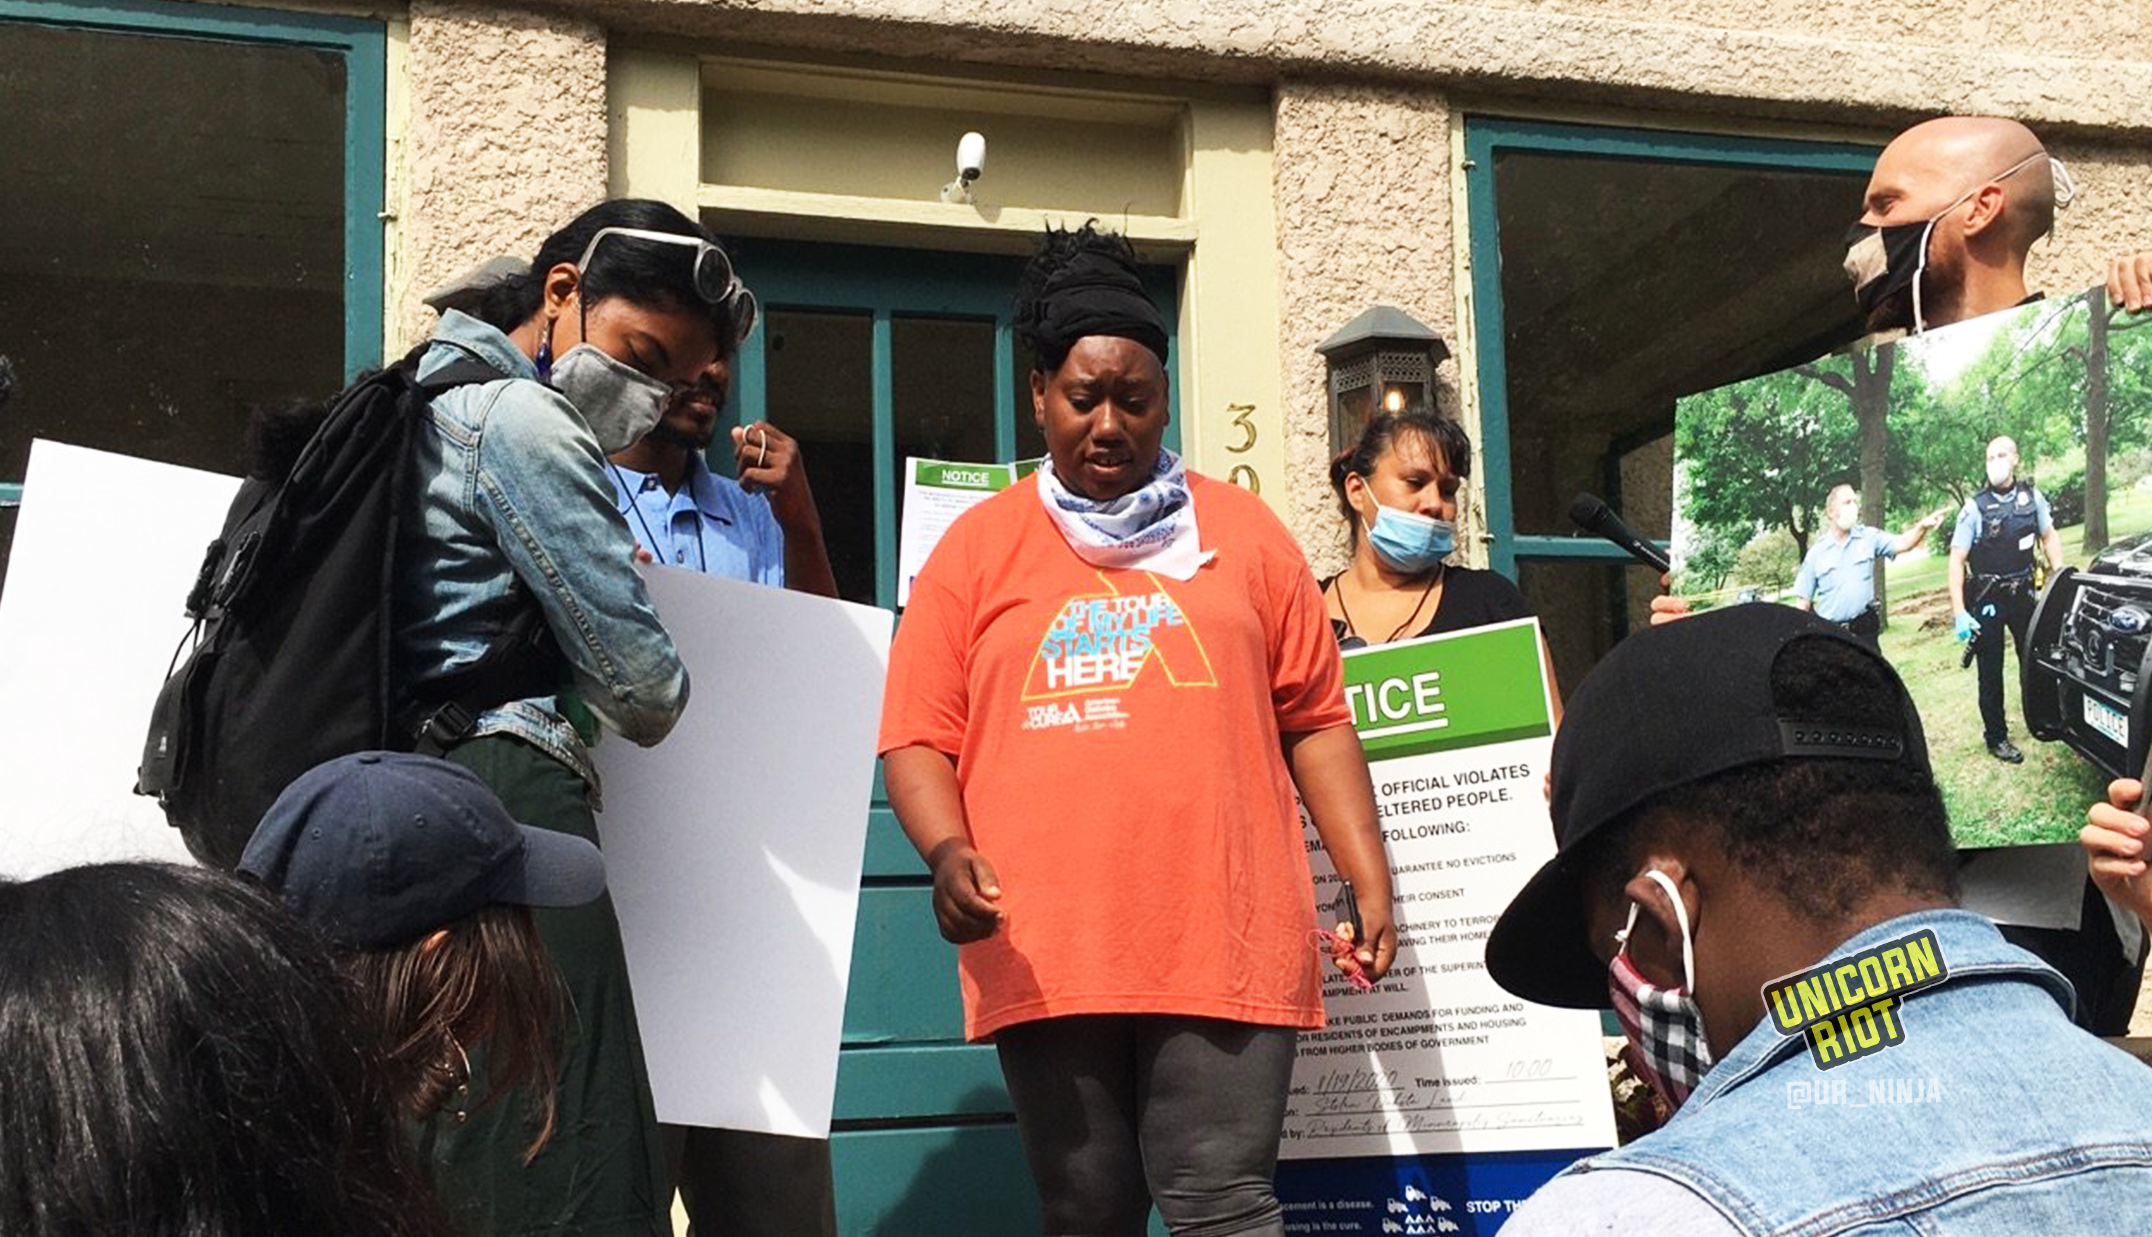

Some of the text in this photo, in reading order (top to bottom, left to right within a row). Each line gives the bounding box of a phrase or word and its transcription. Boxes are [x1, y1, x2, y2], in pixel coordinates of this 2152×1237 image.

[941, 469, 989, 482] NOTICE
[1111, 592, 1172, 614] TOUR
[1041, 625, 1152, 659] STARTS
[1046, 651, 1145, 689] HERE
[1344, 671, 1445, 726] TICE
[2086, 698, 2126, 738] POLICE
[1381, 775, 1450, 797] OFFICIAL
[1453, 763, 1531, 787] VIOLATES
[1376, 787, 1514, 819] ELTERED PEOPLE.
[1381, 820, 1471, 842] FOLLOWING:
[1391, 860, 1444, 876] UARANTEE
[1446, 858, 1461, 869] NO
[1463, 852, 1517, 867] EVICTIONS
[1392, 893, 1416, 904] HEIR
[1418, 888, 1465, 902] CONSENT
[1444, 918, 1457, 928] TO
[1397, 936, 1427, 948] AVING
[1429, 933, 1459, 945] THEIR
[1403, 966, 1417, 977] OF
[1418, 965, 1438, 976] THE
[1440, 960, 1487, 973] SUPERIN
[1322, 987, 1370, 998] AMPMENT
[1343, 1013, 1378, 1025] PUBLIC
[1381, 1009, 1431, 1022] DEMANDS
[1431, 1008, 1453, 1018] FOR
[1455, 1004, 1500, 1016] FUNDING
[1502, 1002, 1524, 1013] AND
[1310, 1029, 1364, 1042] RESIDENTS
[1364, 1028, 1379, 1039] OF
[1380, 1023, 1455, 1037] ENCAMPMENTS
[1457, 1020, 1478, 1031] AND
[1479, 1017, 1527, 1030] HOUSING
[1300, 1046, 1328, 1058] FROM
[1328, 1044, 1366, 1056] HIGHER
[1366, 1040, 1403, 1053] BODIES
[1405, 1039, 1419, 1050] OF
[1420, 1035, 1490, 1049] GOVERNMENT
[1414, 1076, 1440, 1089] Time
[1281, 1201, 1316, 1211] cement
[1465, 1200, 1501, 1213] STOP
[1502, 1199, 1526, 1213] TH
[1285, 1221, 1310, 1233] using
